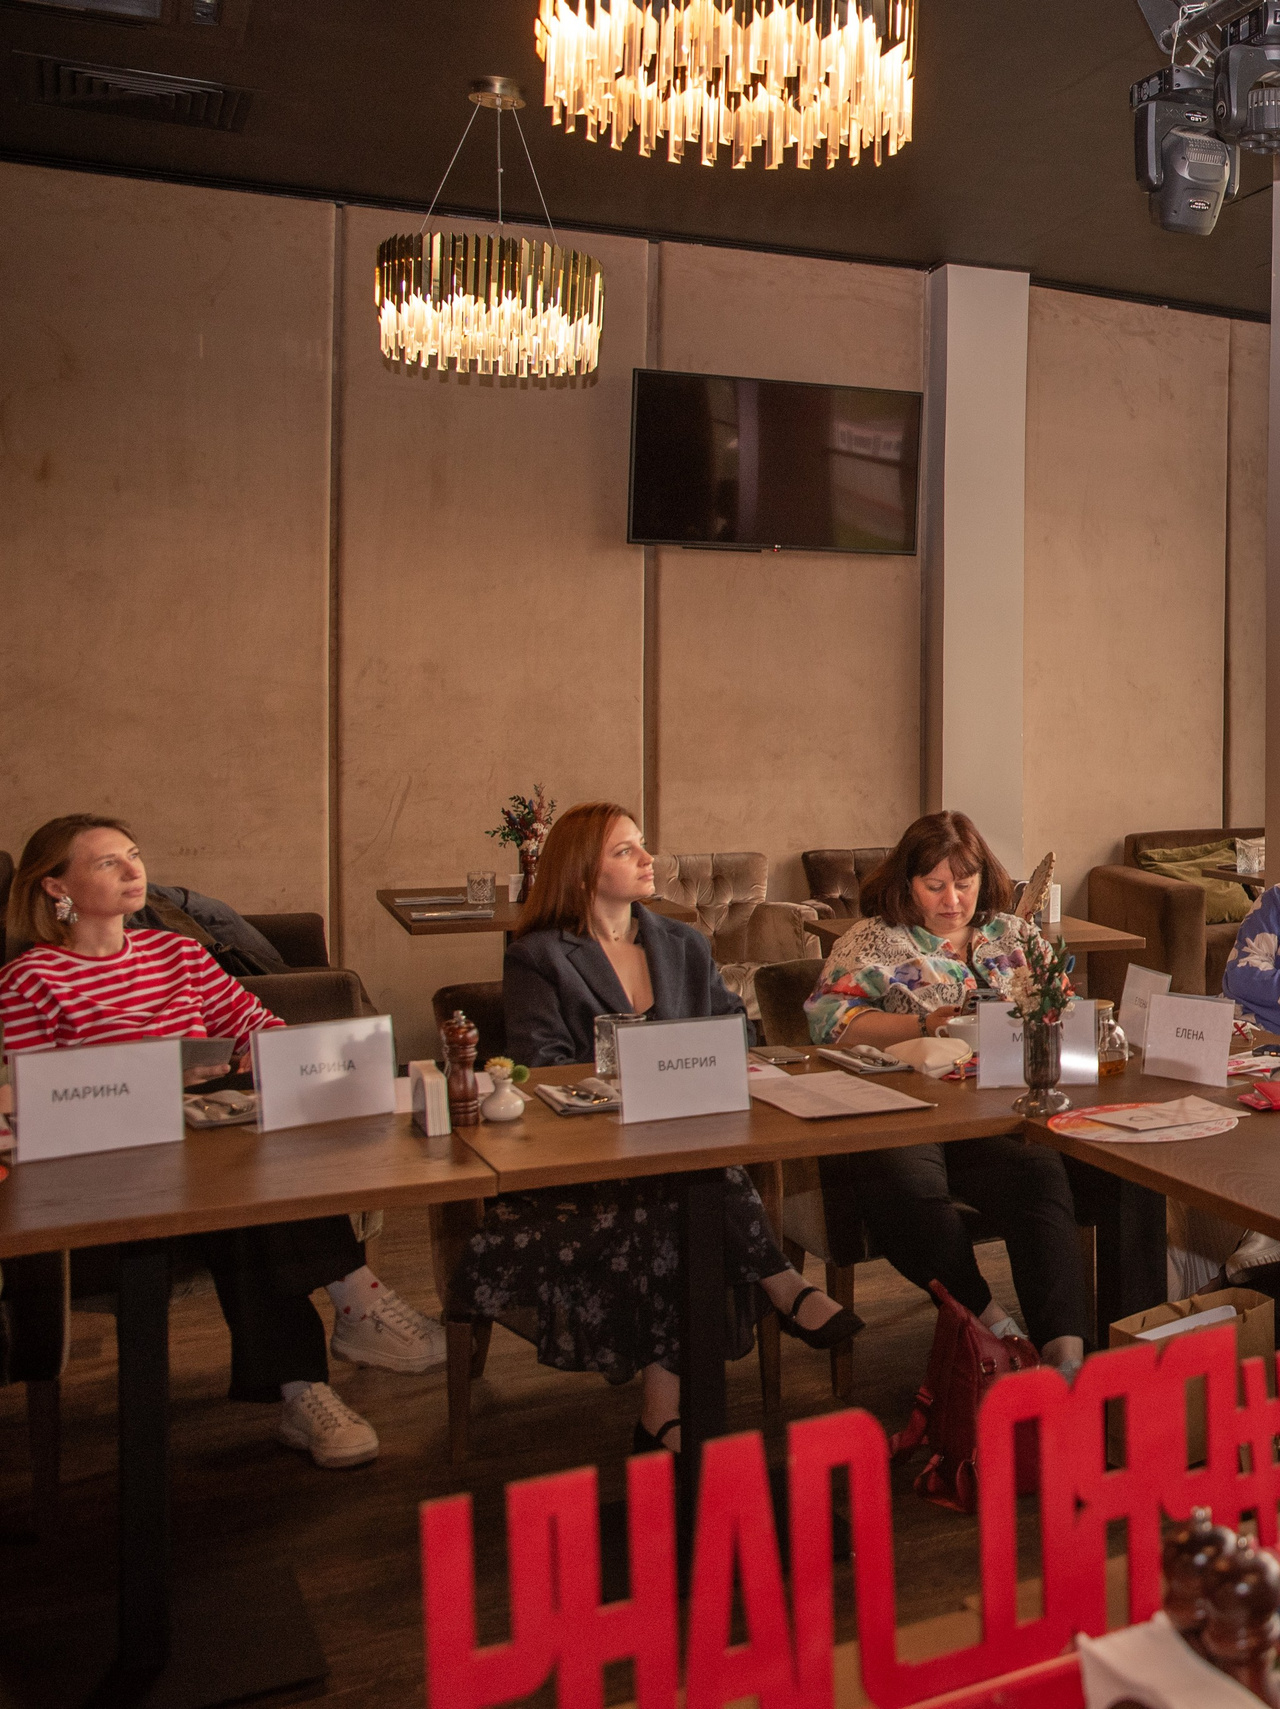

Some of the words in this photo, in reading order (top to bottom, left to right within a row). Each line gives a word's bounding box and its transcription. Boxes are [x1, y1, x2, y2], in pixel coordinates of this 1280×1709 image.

[1175, 1026, 1205, 1042] ЕЛЕНА
[300, 1059, 357, 1076] КАРИНА
[657, 1055, 717, 1073] ВАЛЕРИЯ
[51, 1082, 131, 1103] МАРИНА
